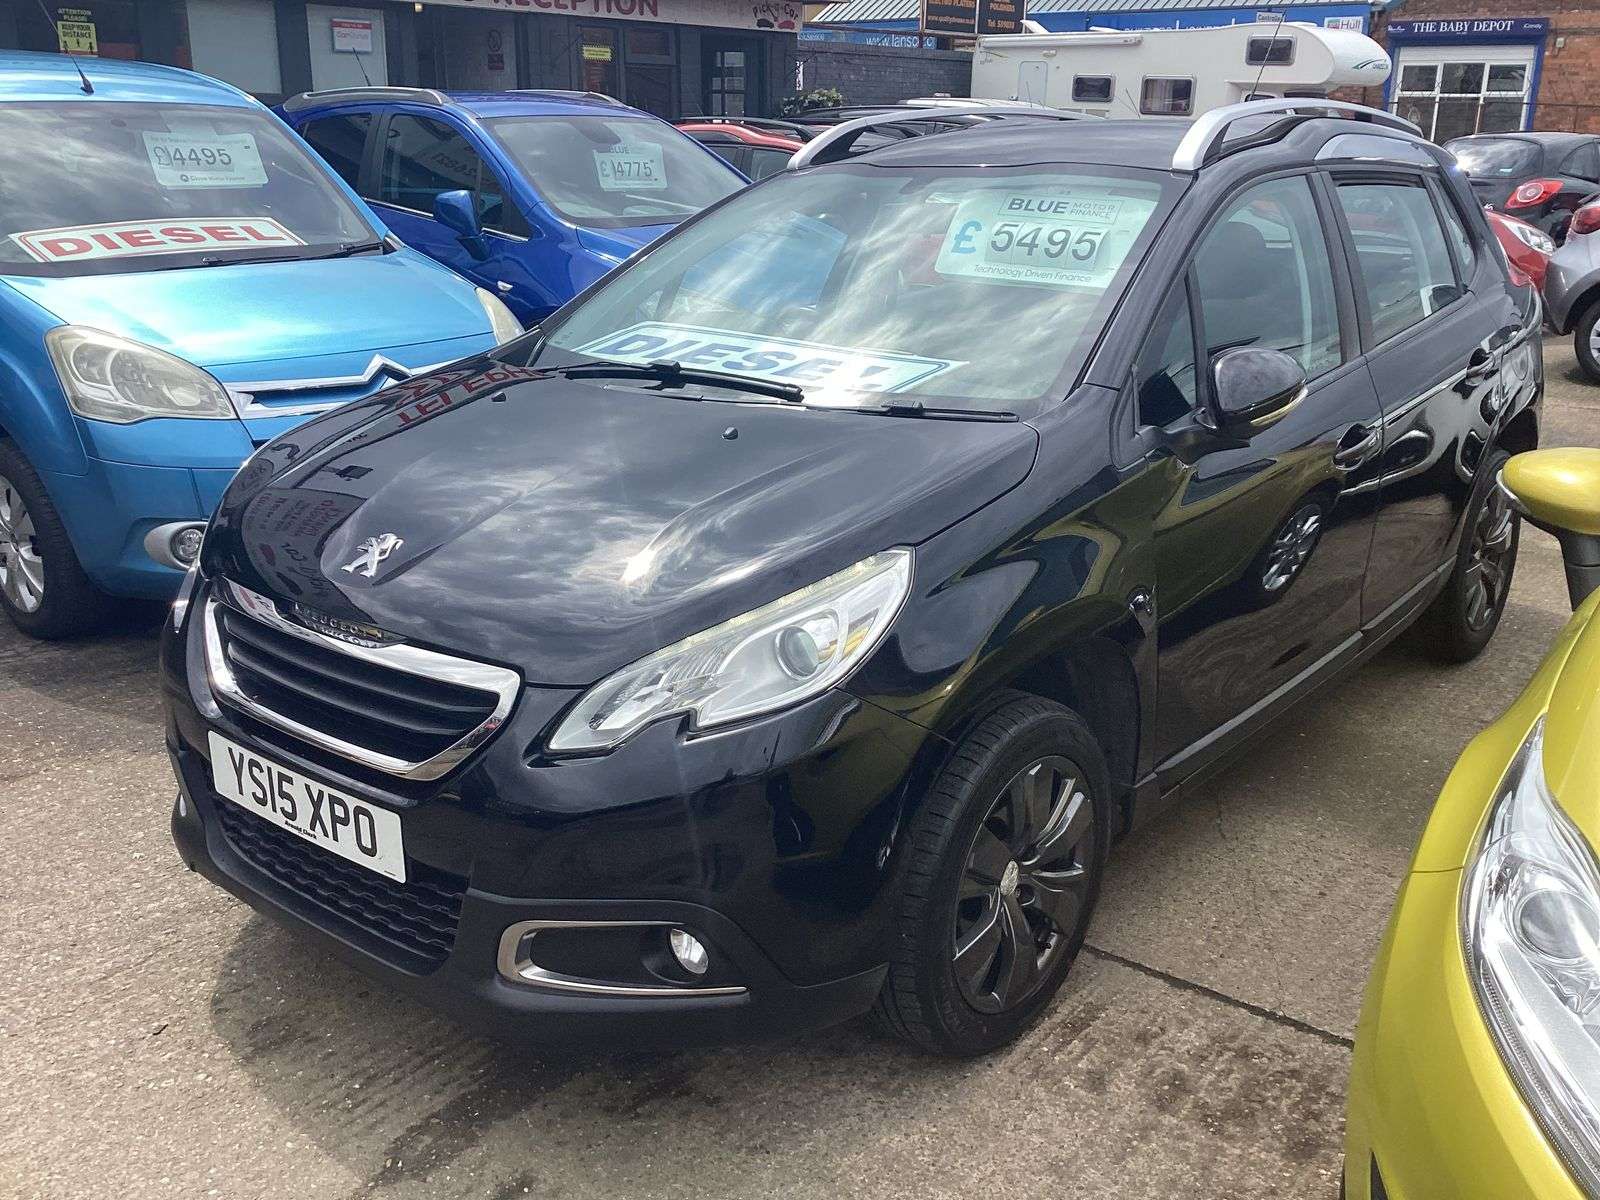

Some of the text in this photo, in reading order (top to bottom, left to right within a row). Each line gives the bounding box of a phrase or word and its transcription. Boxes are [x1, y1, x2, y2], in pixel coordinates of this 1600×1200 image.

[1341, 19, 1361, 30] Hull
[1412, 22, 1437, 33] THE
[1440, 21, 1471, 32] BABY
[1473, 20, 1515, 32] DEPOT
[62, 31, 91, 39] DISTANCE
[1007, 197, 1070, 215] BLUE
[39, 225, 285, 257] DIESEL
[974, 263, 1093, 284] Technology Driven Finance
[227, 746, 378, 858] YS15 XPO
